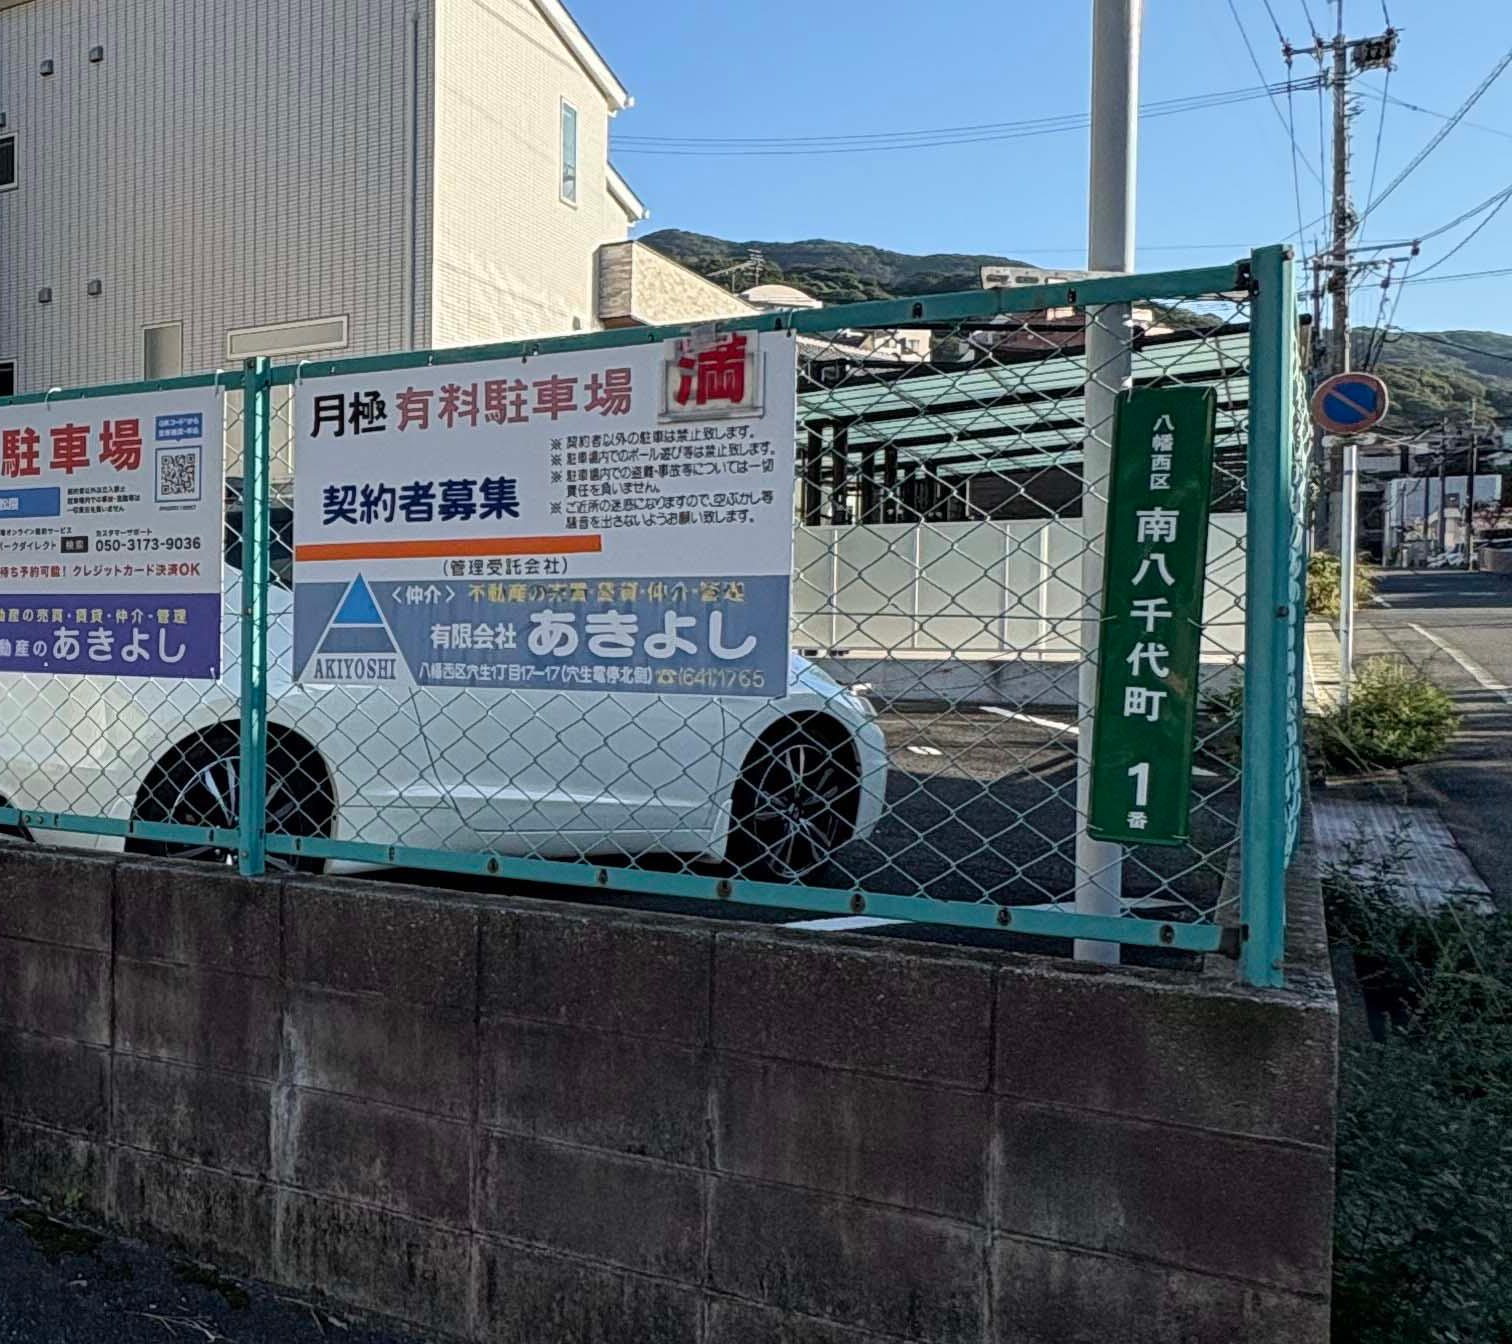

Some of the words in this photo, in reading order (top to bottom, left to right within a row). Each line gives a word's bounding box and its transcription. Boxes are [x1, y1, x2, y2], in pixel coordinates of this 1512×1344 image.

[675, 332, 747, 405] 満
[1149, 413, 1174, 490] 八幡西区
[322, 476, 521, 525] 契約者募集
[95, 537, 201, 552] 050-3173-9036
[1123, 506, 1180, 722] 南八千代町
[313, 656, 398, 680] AKIYOSHI
